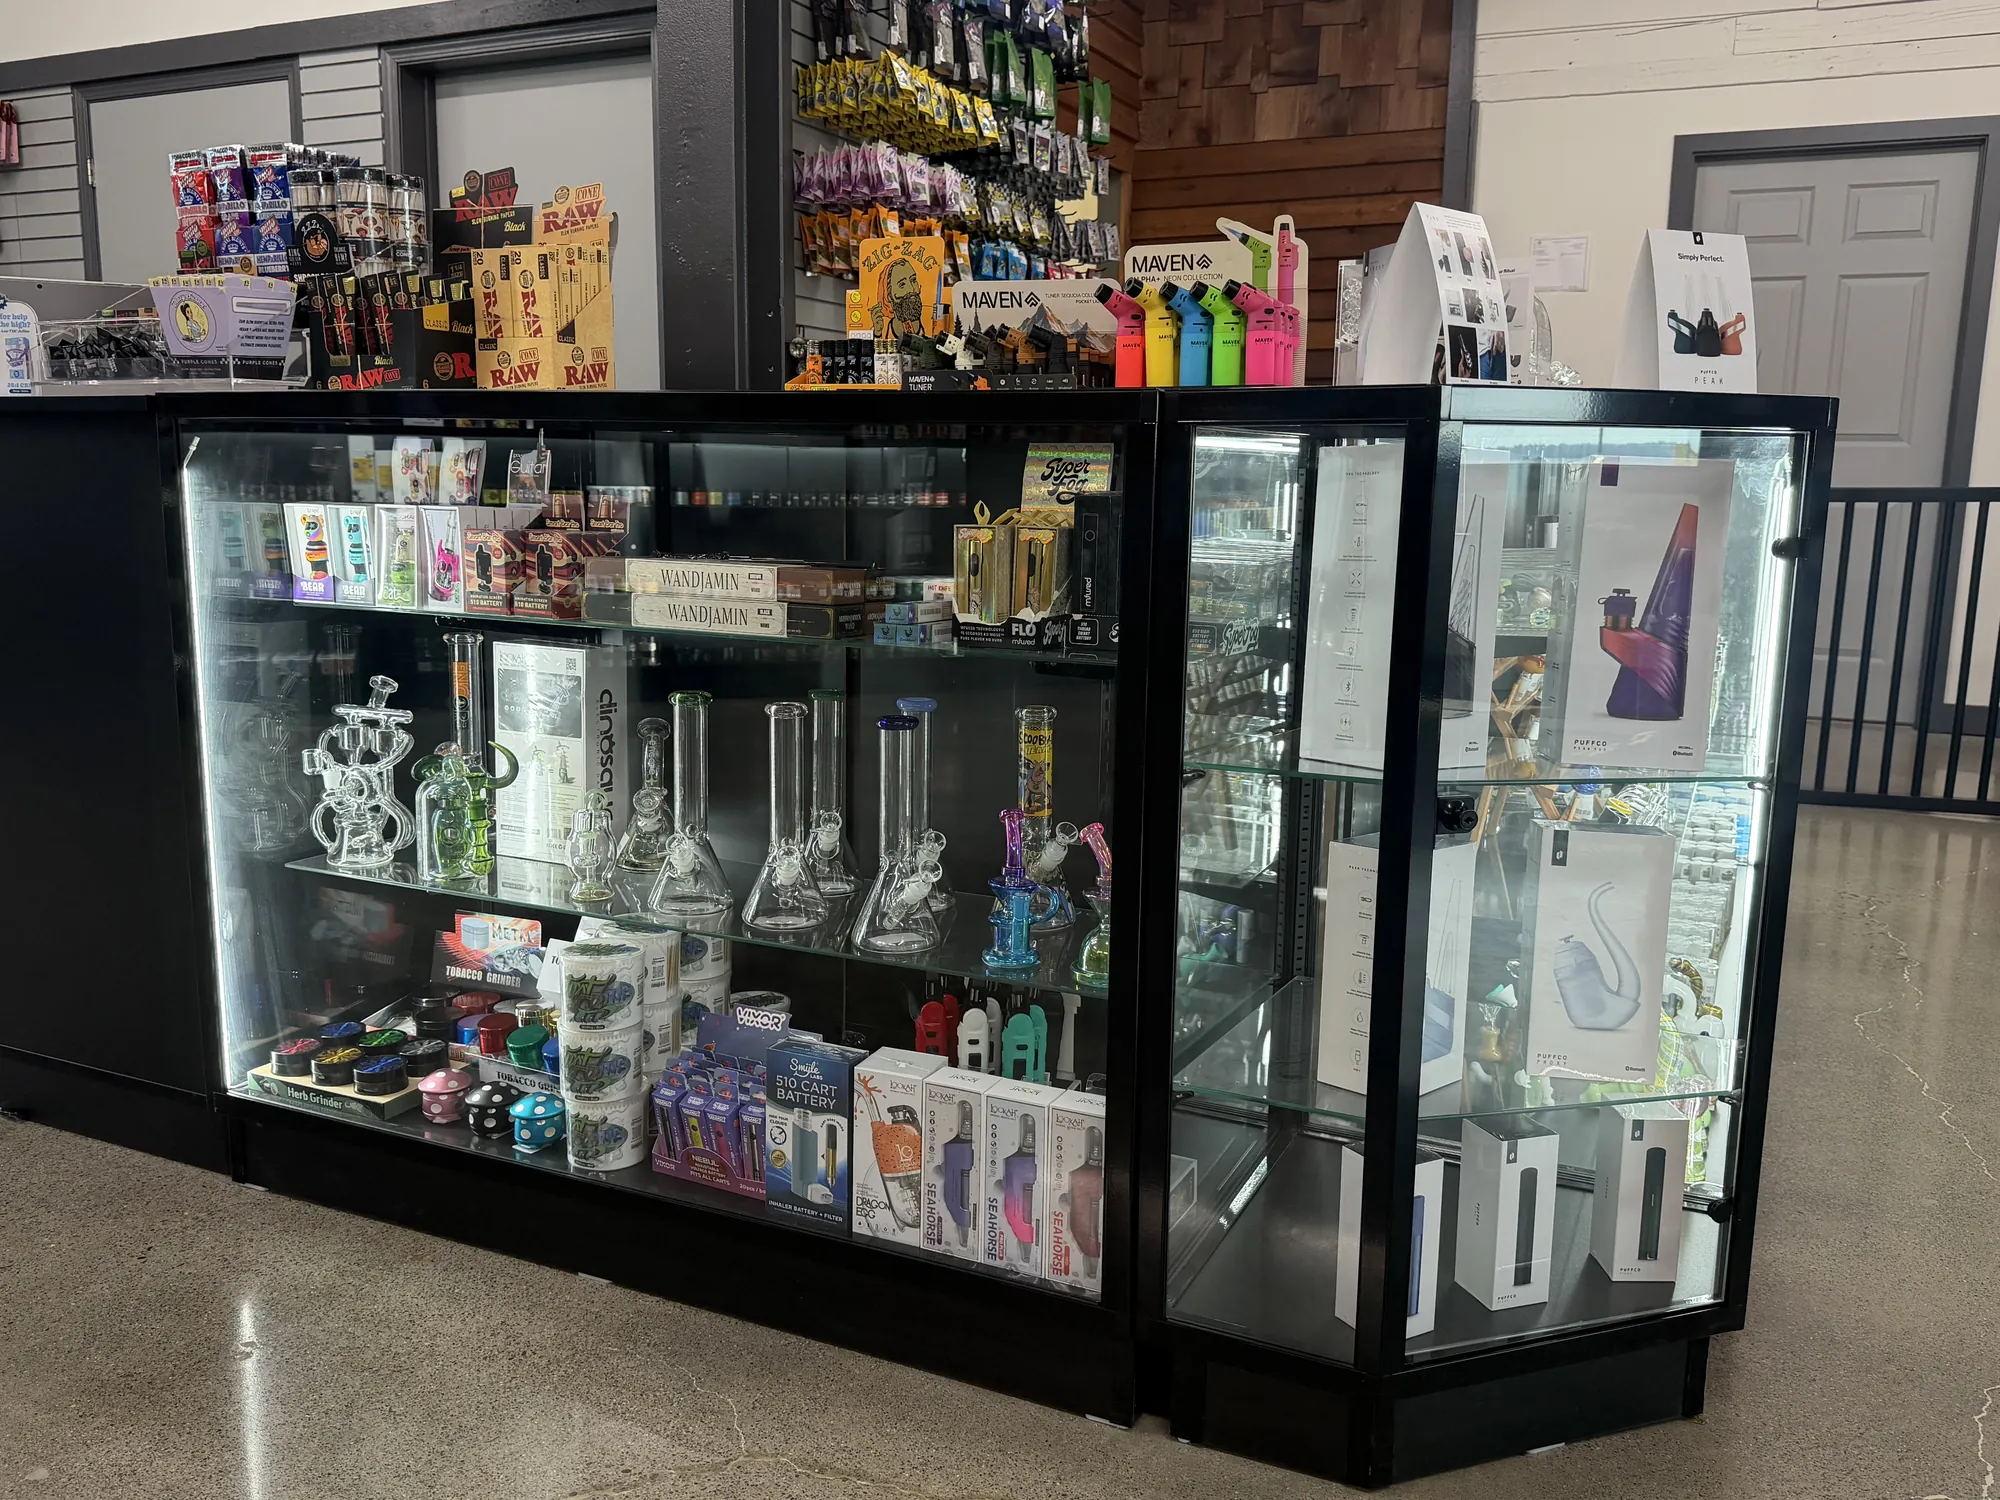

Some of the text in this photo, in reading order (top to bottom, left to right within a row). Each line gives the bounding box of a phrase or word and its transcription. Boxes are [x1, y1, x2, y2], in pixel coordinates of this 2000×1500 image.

[577, 187, 599, 200] CONE
[454, 188, 517, 222] RAW
[542, 200, 603, 234] RAW
[504, 221, 526, 232] Black
[862, 240, 939, 273] ZIG-ZAG
[1132, 253, 1194, 273] MAVEN
[1678, 252, 1725, 263] Simply Perfect.
[1183, 273, 1223, 281] COLLECTION
[962, 291, 1023, 309] MAVEN
[425, 318, 448, 329] CLASSIC
[452, 321, 473, 334] Black
[375, 356, 394, 365] Black
[521, 350, 538, 361] CONE
[592, 348, 607, 361] CONE
[340, 368, 385, 390] RAW
[490, 362, 540, 388] RAW
[564, 362, 609, 386] RAW
[1694, 376, 1724, 385] PEAK
[423, 379, 430, 389] 6
[300, 581, 325, 593] BEAR
[661, 569, 739, 593] WANDJAMIN
[342, 585, 366, 596] BEAR
[1084, 577, 1093, 607] mfused
[481, 599, 503, 607] BATTERY
[525, 602, 548, 610] BATTERY
[668, 603, 748, 628] WANDJAMIN
[1011, 623, 1037, 637] FLO
[1011, 637, 1036, 646] mfused
[1574, 739, 1607, 747] PUFFCO
[446, 965, 521, 988] TOBACCO GRINDER
[736, 1006, 787, 1032] VIXOR
[1536, 1052, 1568, 1061] PUFFCO
[496, 1071, 536, 1088] TOBACCO
[810, 1073, 823, 1081] LABS
[776, 1075, 838, 1097] 510 CART
[287, 1086, 343, 1110] Herb Grinder
[777, 1088, 837, 1110] BATTERY
[690, 1170, 702, 1178] FITS
[712, 1176, 731, 1186] CARTS
[768, 1199, 793, 1211] INHALER
[793, 1205, 819, 1217] BATTERY
[823, 1213, 843, 1223] FILTER
[856, 1195, 891, 1212] DRAGON
[856, 1206, 876, 1220] EGG
[926, 1182, 937, 1246] SEAHORSE
[988, 1197, 998, 1262] SEAHORSE
[1052, 1211, 1064, 1277] SEAHORSE
[1497, 1293, 1517, 1301] PUFFCO
